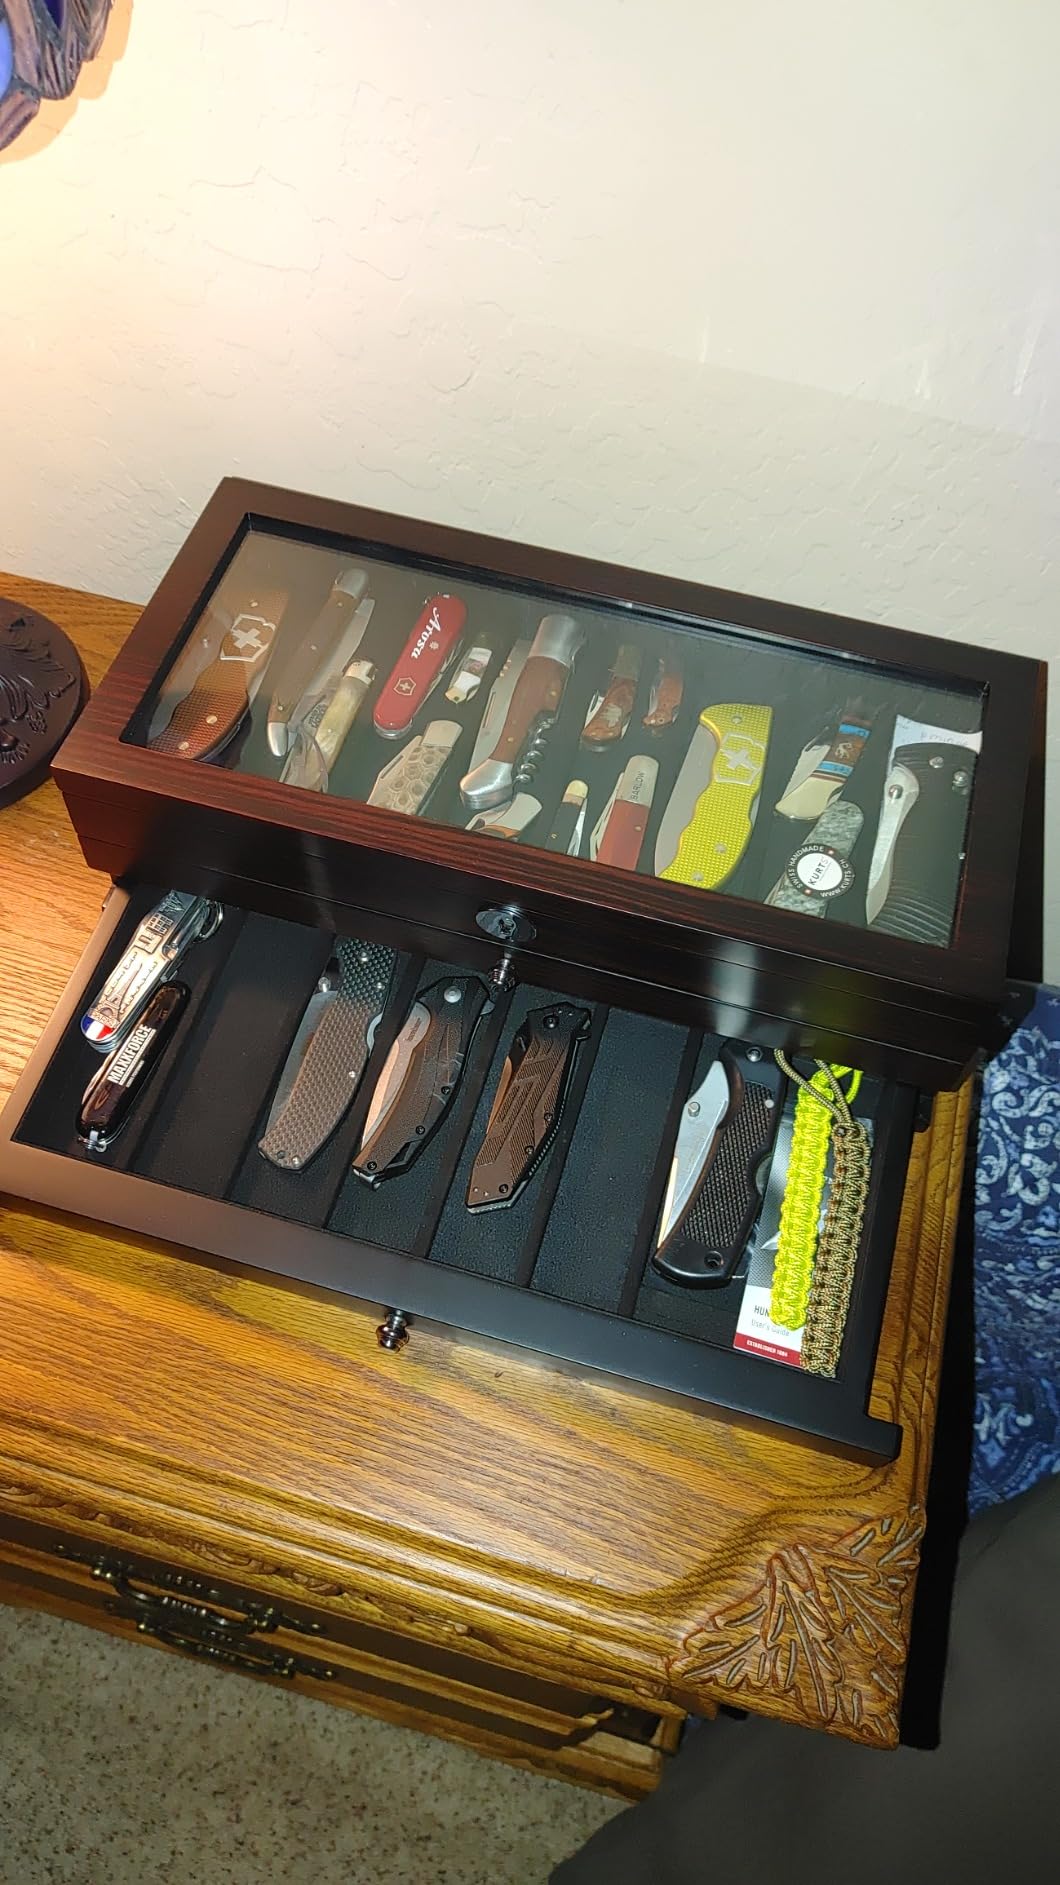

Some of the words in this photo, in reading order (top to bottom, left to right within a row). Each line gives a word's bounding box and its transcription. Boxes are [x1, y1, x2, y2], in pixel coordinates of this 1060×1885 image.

[411, 607, 441, 659] Arosa
[631, 770, 645, 800] BARLOW
[788, 845, 825, 867] HANDMADE
[788, 868, 803, 889] SWISS
[107, 1023, 152, 1084] MAXXFORCE
[754, 1304, 770, 1318] HUN
[751, 1318, 770, 1331] User's
